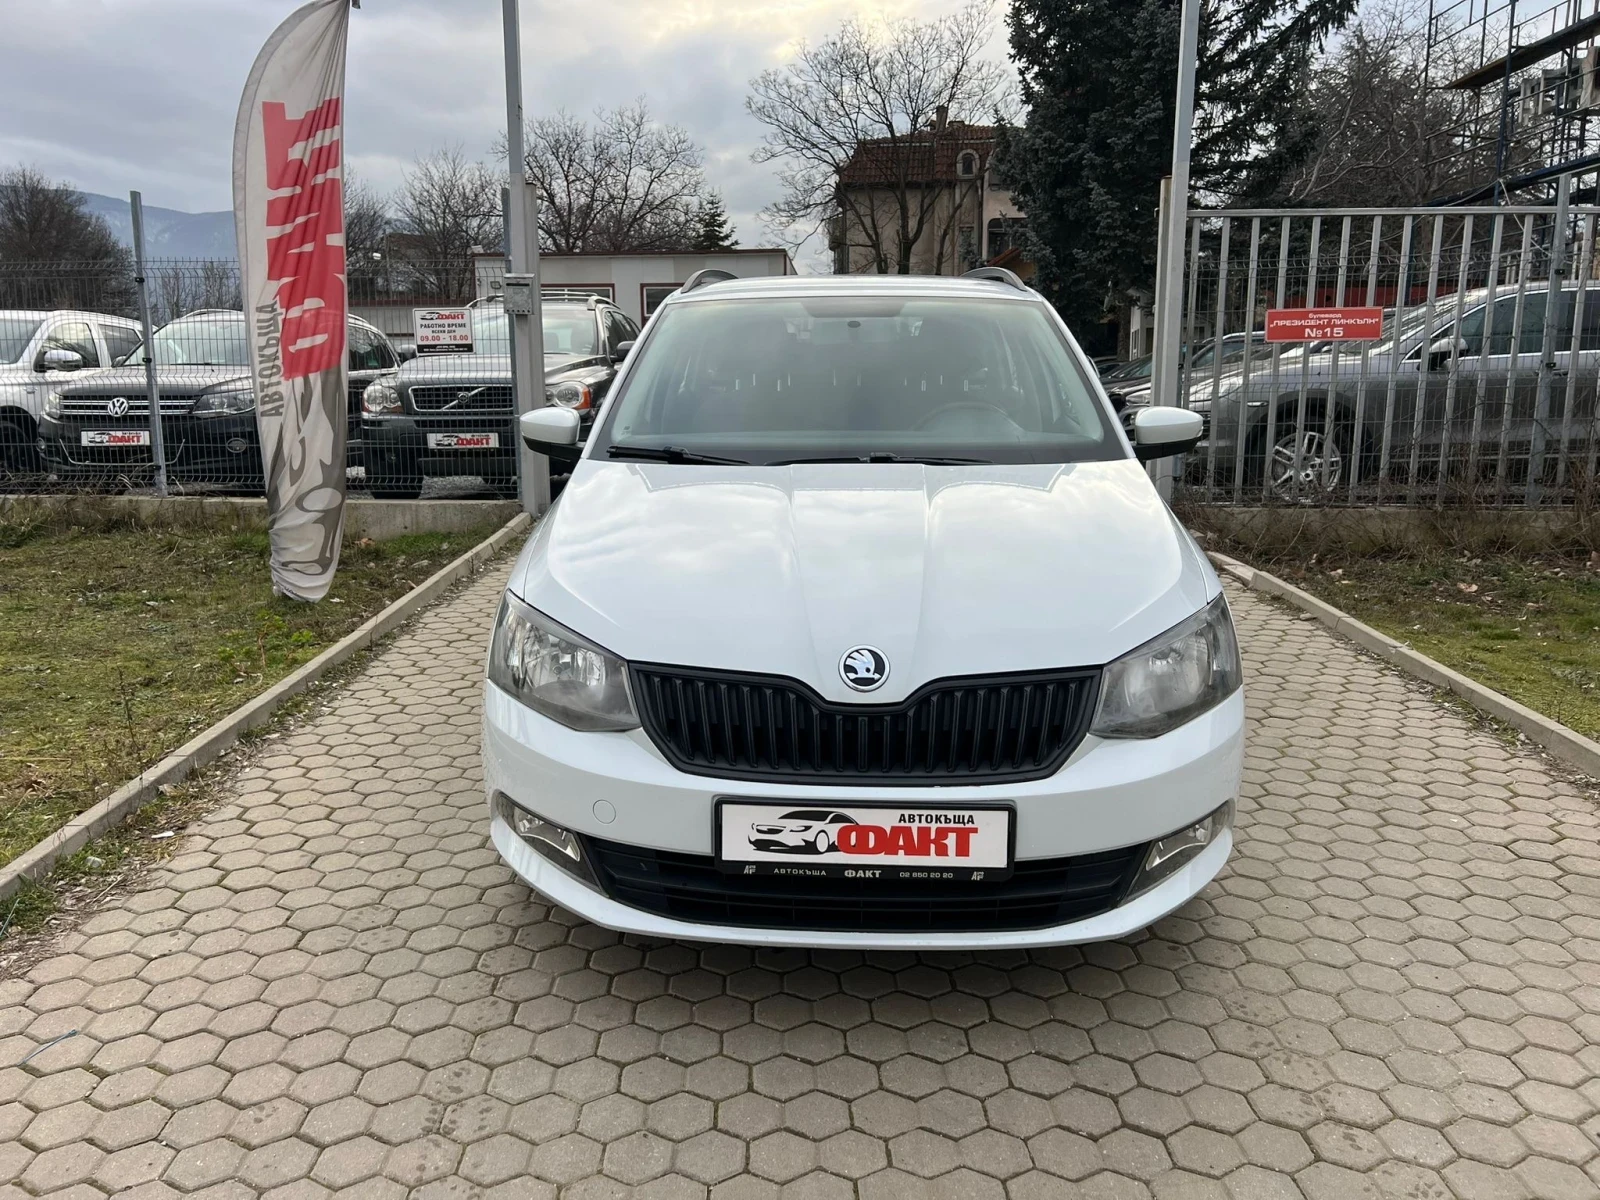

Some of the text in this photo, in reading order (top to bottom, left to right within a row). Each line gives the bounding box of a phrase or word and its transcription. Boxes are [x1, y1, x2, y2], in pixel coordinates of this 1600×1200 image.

[256, 300, 284, 417] АВТОКЪЩА
[898, 813, 975, 825] АВТОКЪЩА
[836, 824, 978, 857] ФАКТ
[844, 869, 882, 878] ФАКТ
